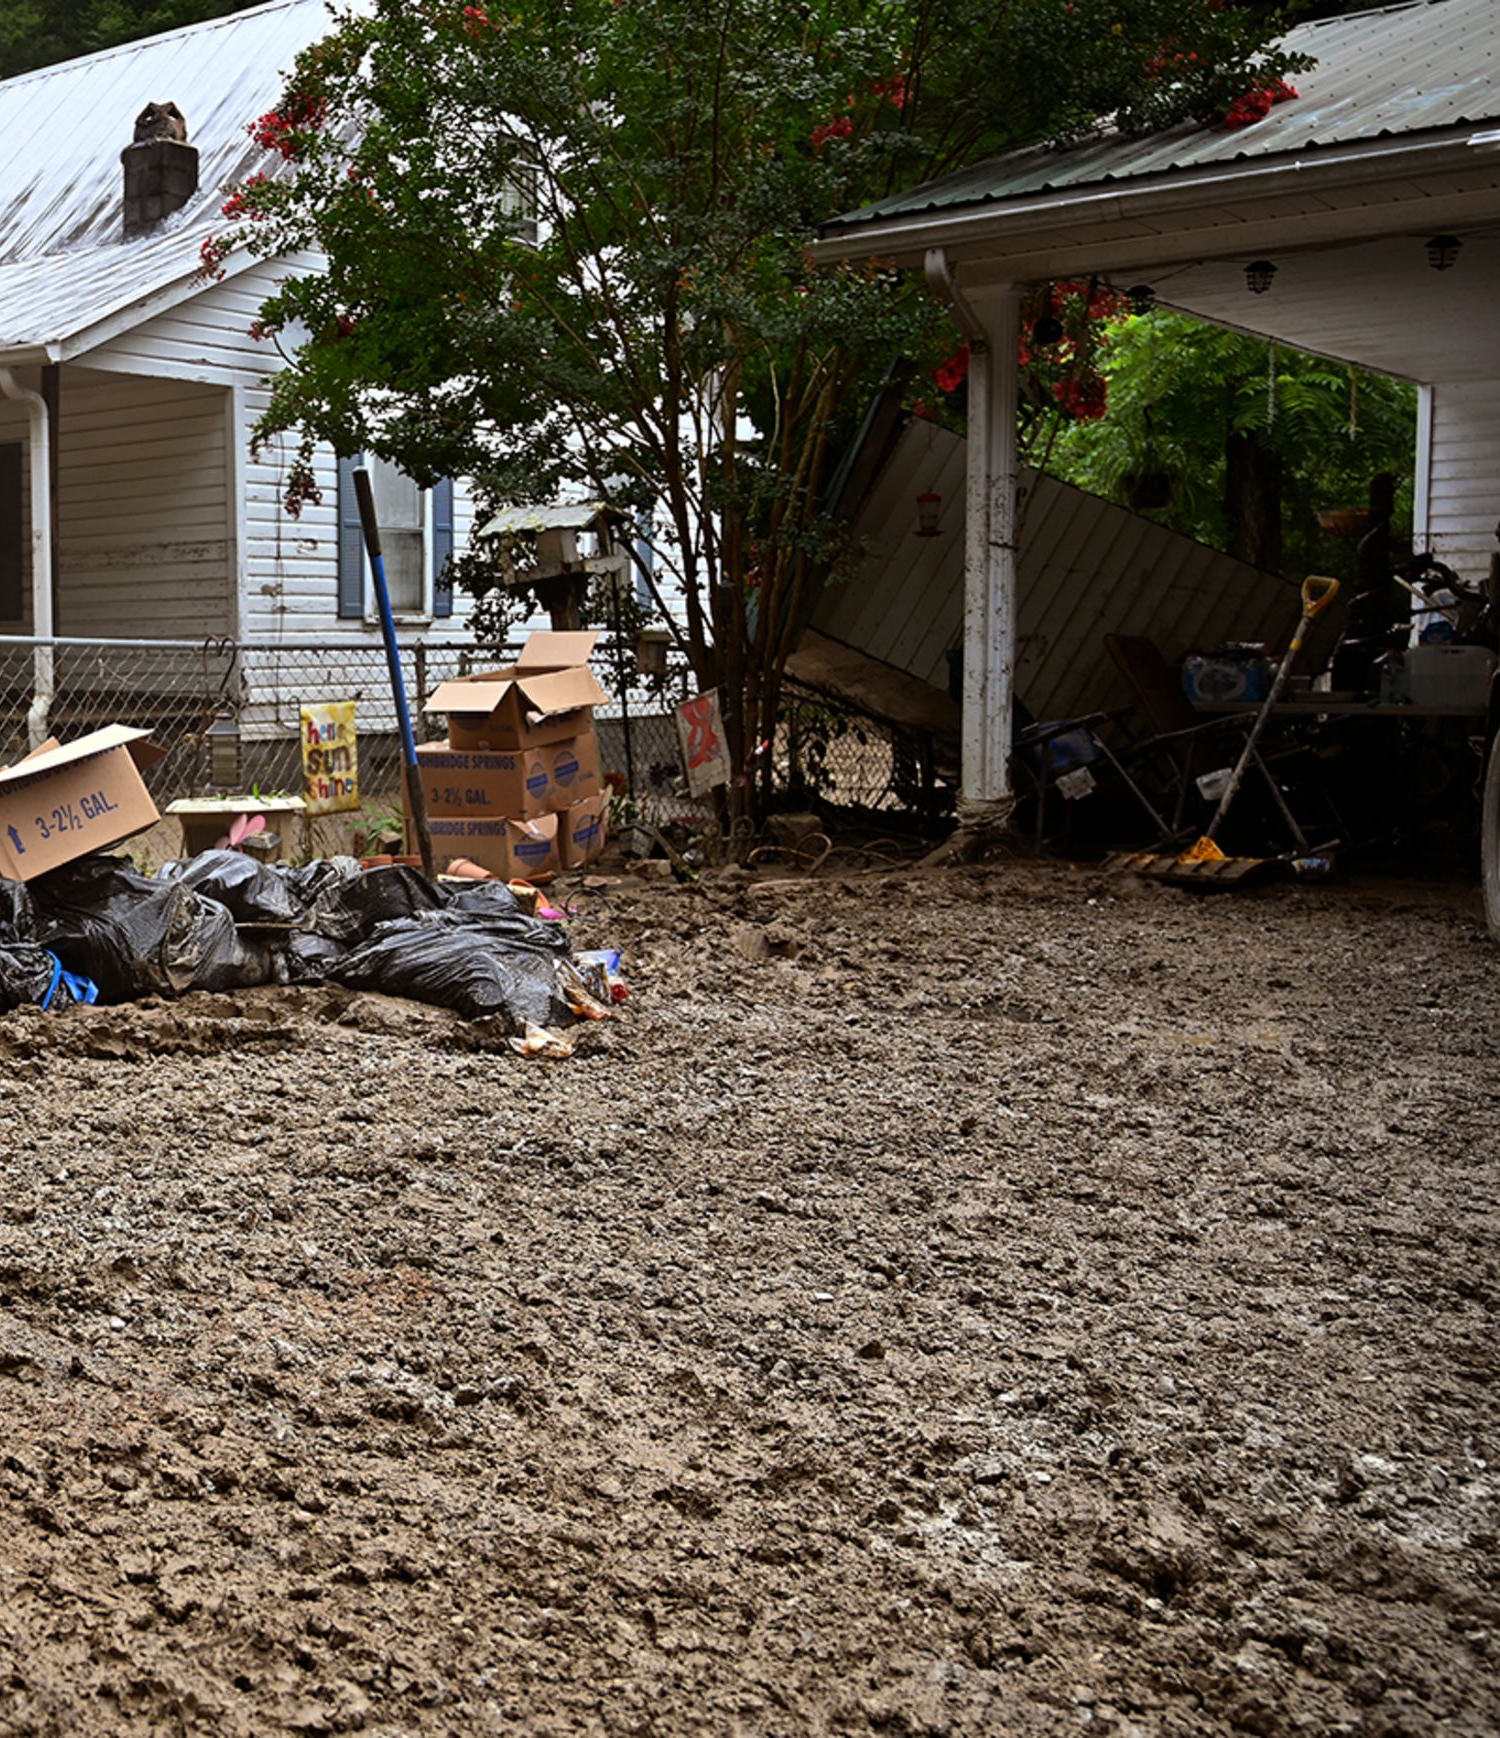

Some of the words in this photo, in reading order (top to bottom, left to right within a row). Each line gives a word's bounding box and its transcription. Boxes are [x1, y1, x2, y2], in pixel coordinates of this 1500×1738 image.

[307, 745, 352, 775] sun
[472, 754, 516, 770] SPRINGS
[308, 777, 354, 800] shine
[465, 788, 492, 805] GAL.
[80, 791, 119, 819] GAL.
[467, 820, 507, 837] SPRINGS
